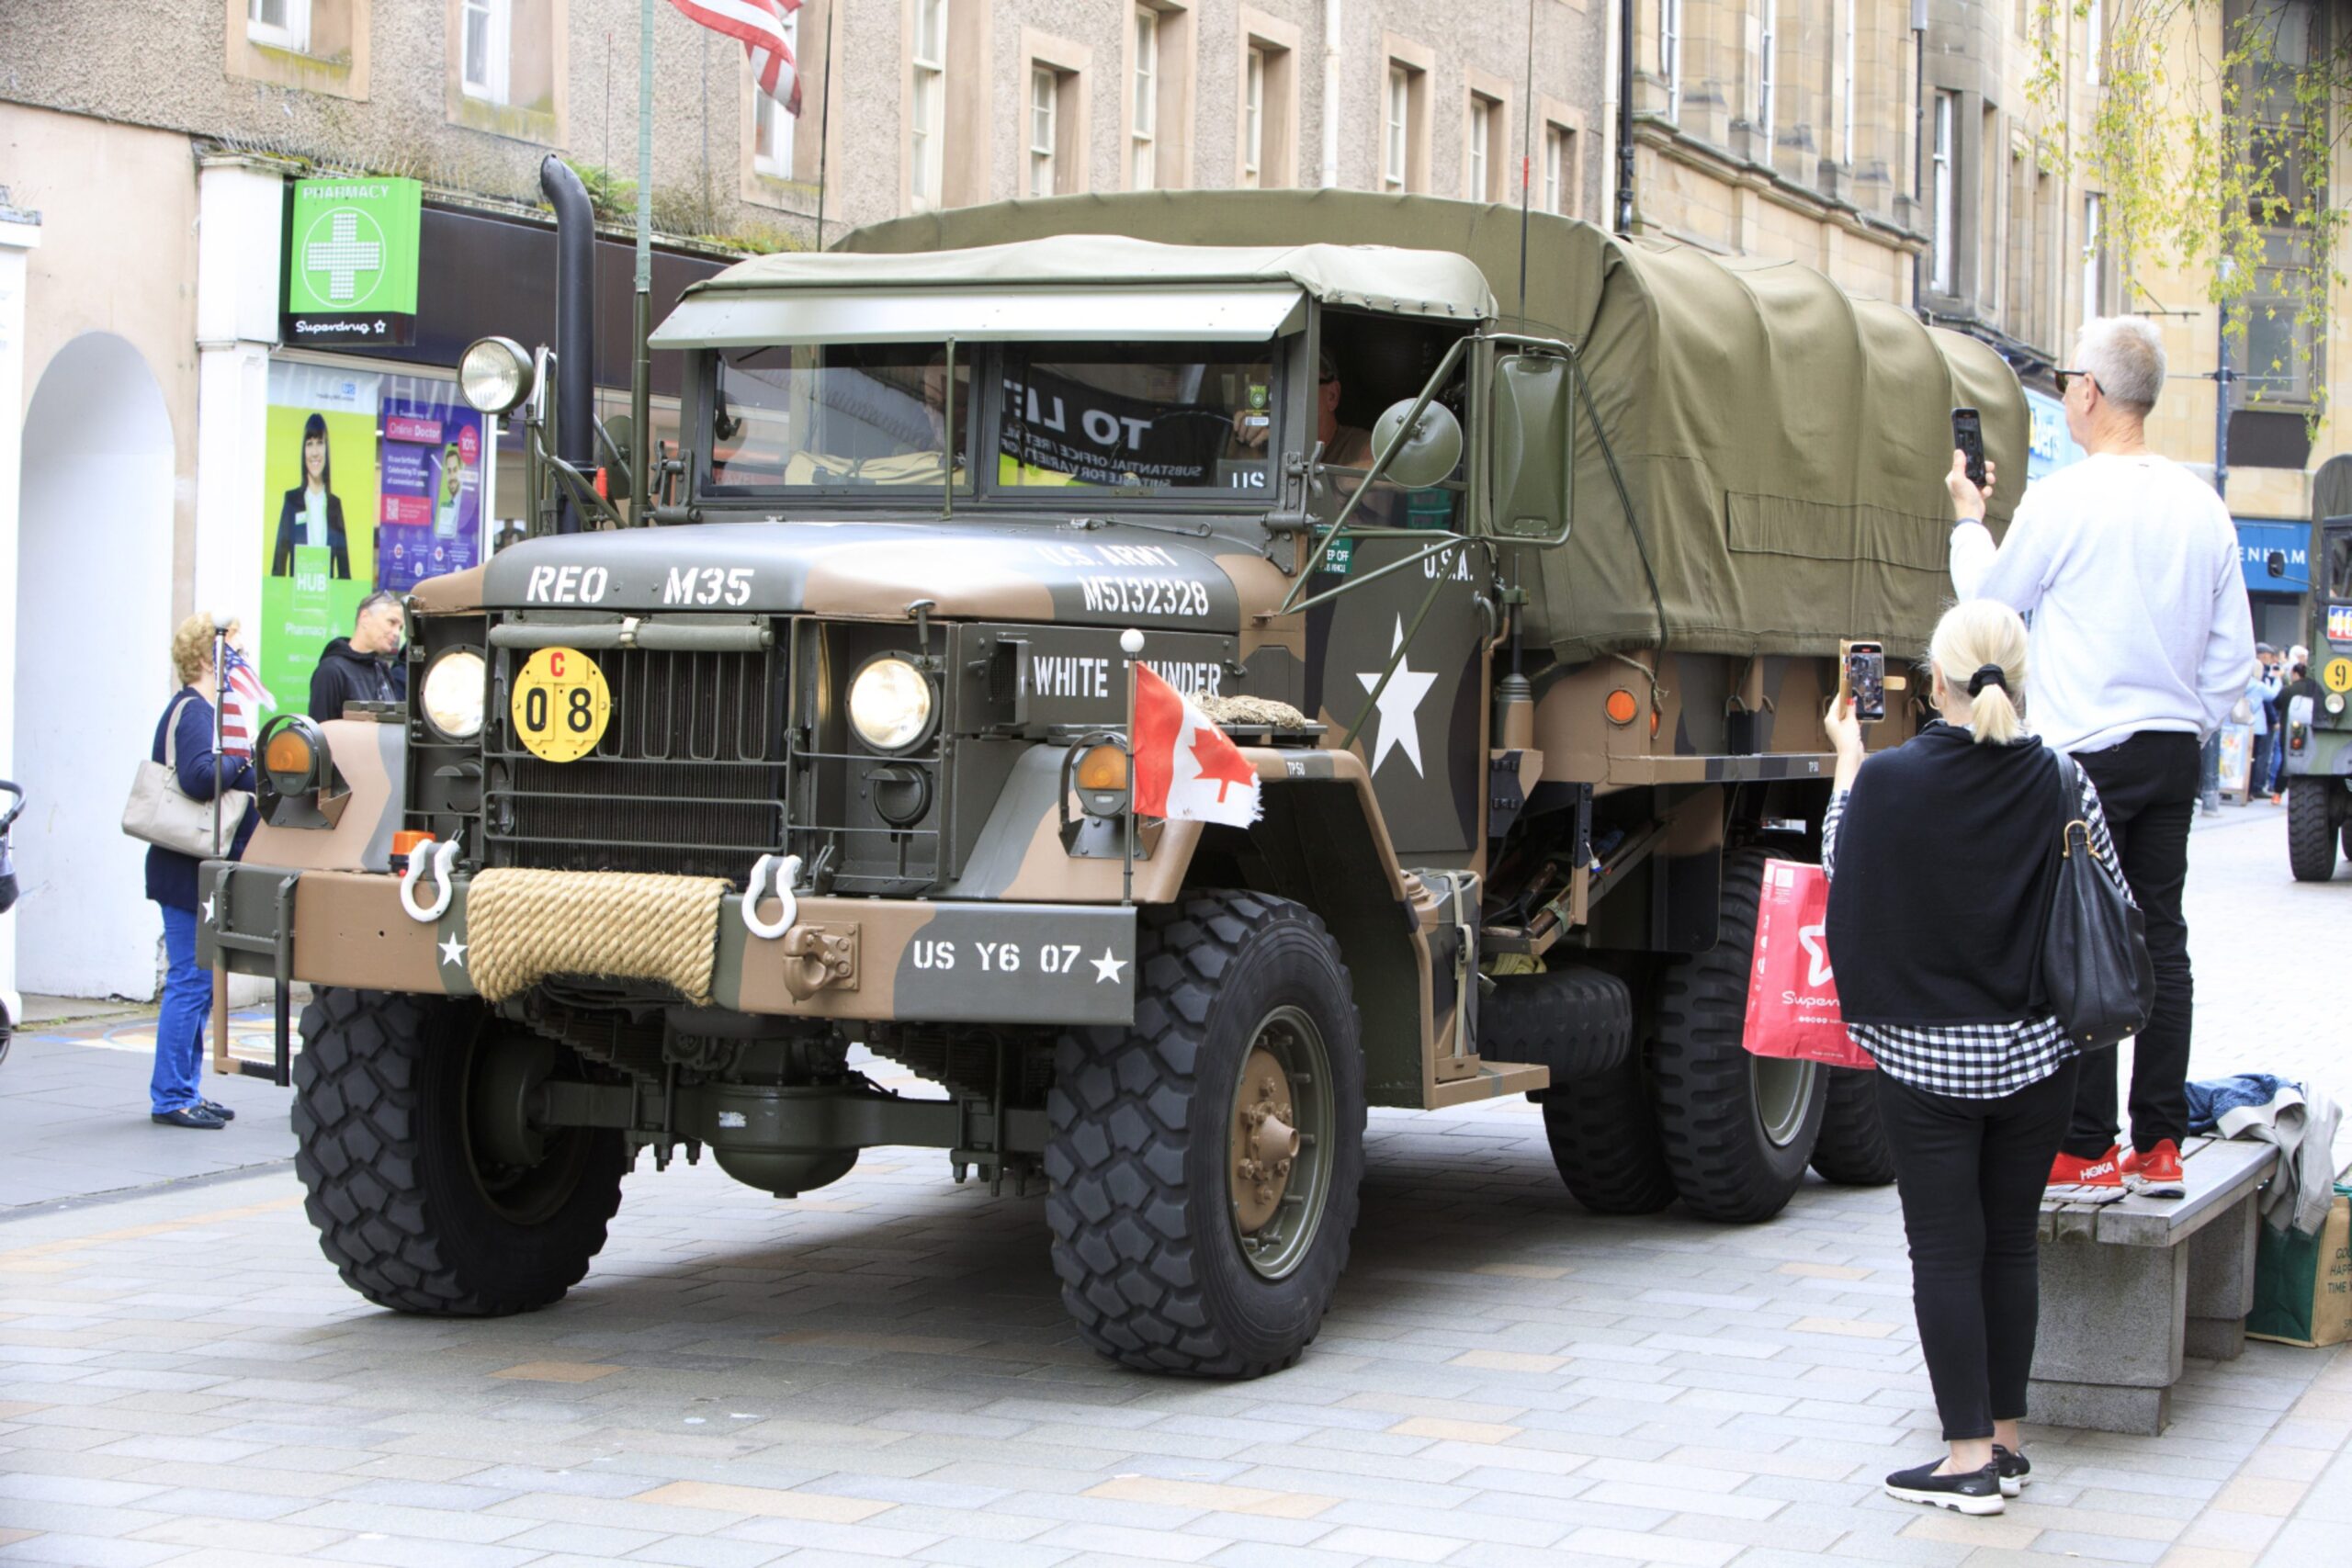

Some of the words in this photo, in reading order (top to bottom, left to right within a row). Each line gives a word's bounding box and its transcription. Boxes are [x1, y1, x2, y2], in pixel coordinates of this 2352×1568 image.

[302, 185, 390, 199] PHARMACY
[295, 320, 370, 334] Superdrug
[390, 422, 413, 435] Online
[413, 423, 441, 438] Doctor
[461, 436, 476, 451] 10%
[1035, 545, 1103, 567] U.S.
[1094, 545, 1179, 567] ARMY
[1336, 549, 1350, 562] OFF
[297, 572, 327, 592] HUB
[526, 565, 608, 604] REO
[662, 567, 755, 606] M35
[1076, 575, 1210, 616] M5132328
[285, 622, 327, 639] Pharmacy
[550, 652, 565, 677] C
[1034, 656, 1109, 698] WHITE
[1123, 659, 1222, 700] NDER
[2335, 664, 2347, 687] 9
[913, 940, 956, 970] US
[975, 942, 1021, 972] Y6
[1040, 944, 1081, 974] 07
[2079, 1161, 2115, 1181] HOKA
[2327, 1281, 2347, 1294] TIME
